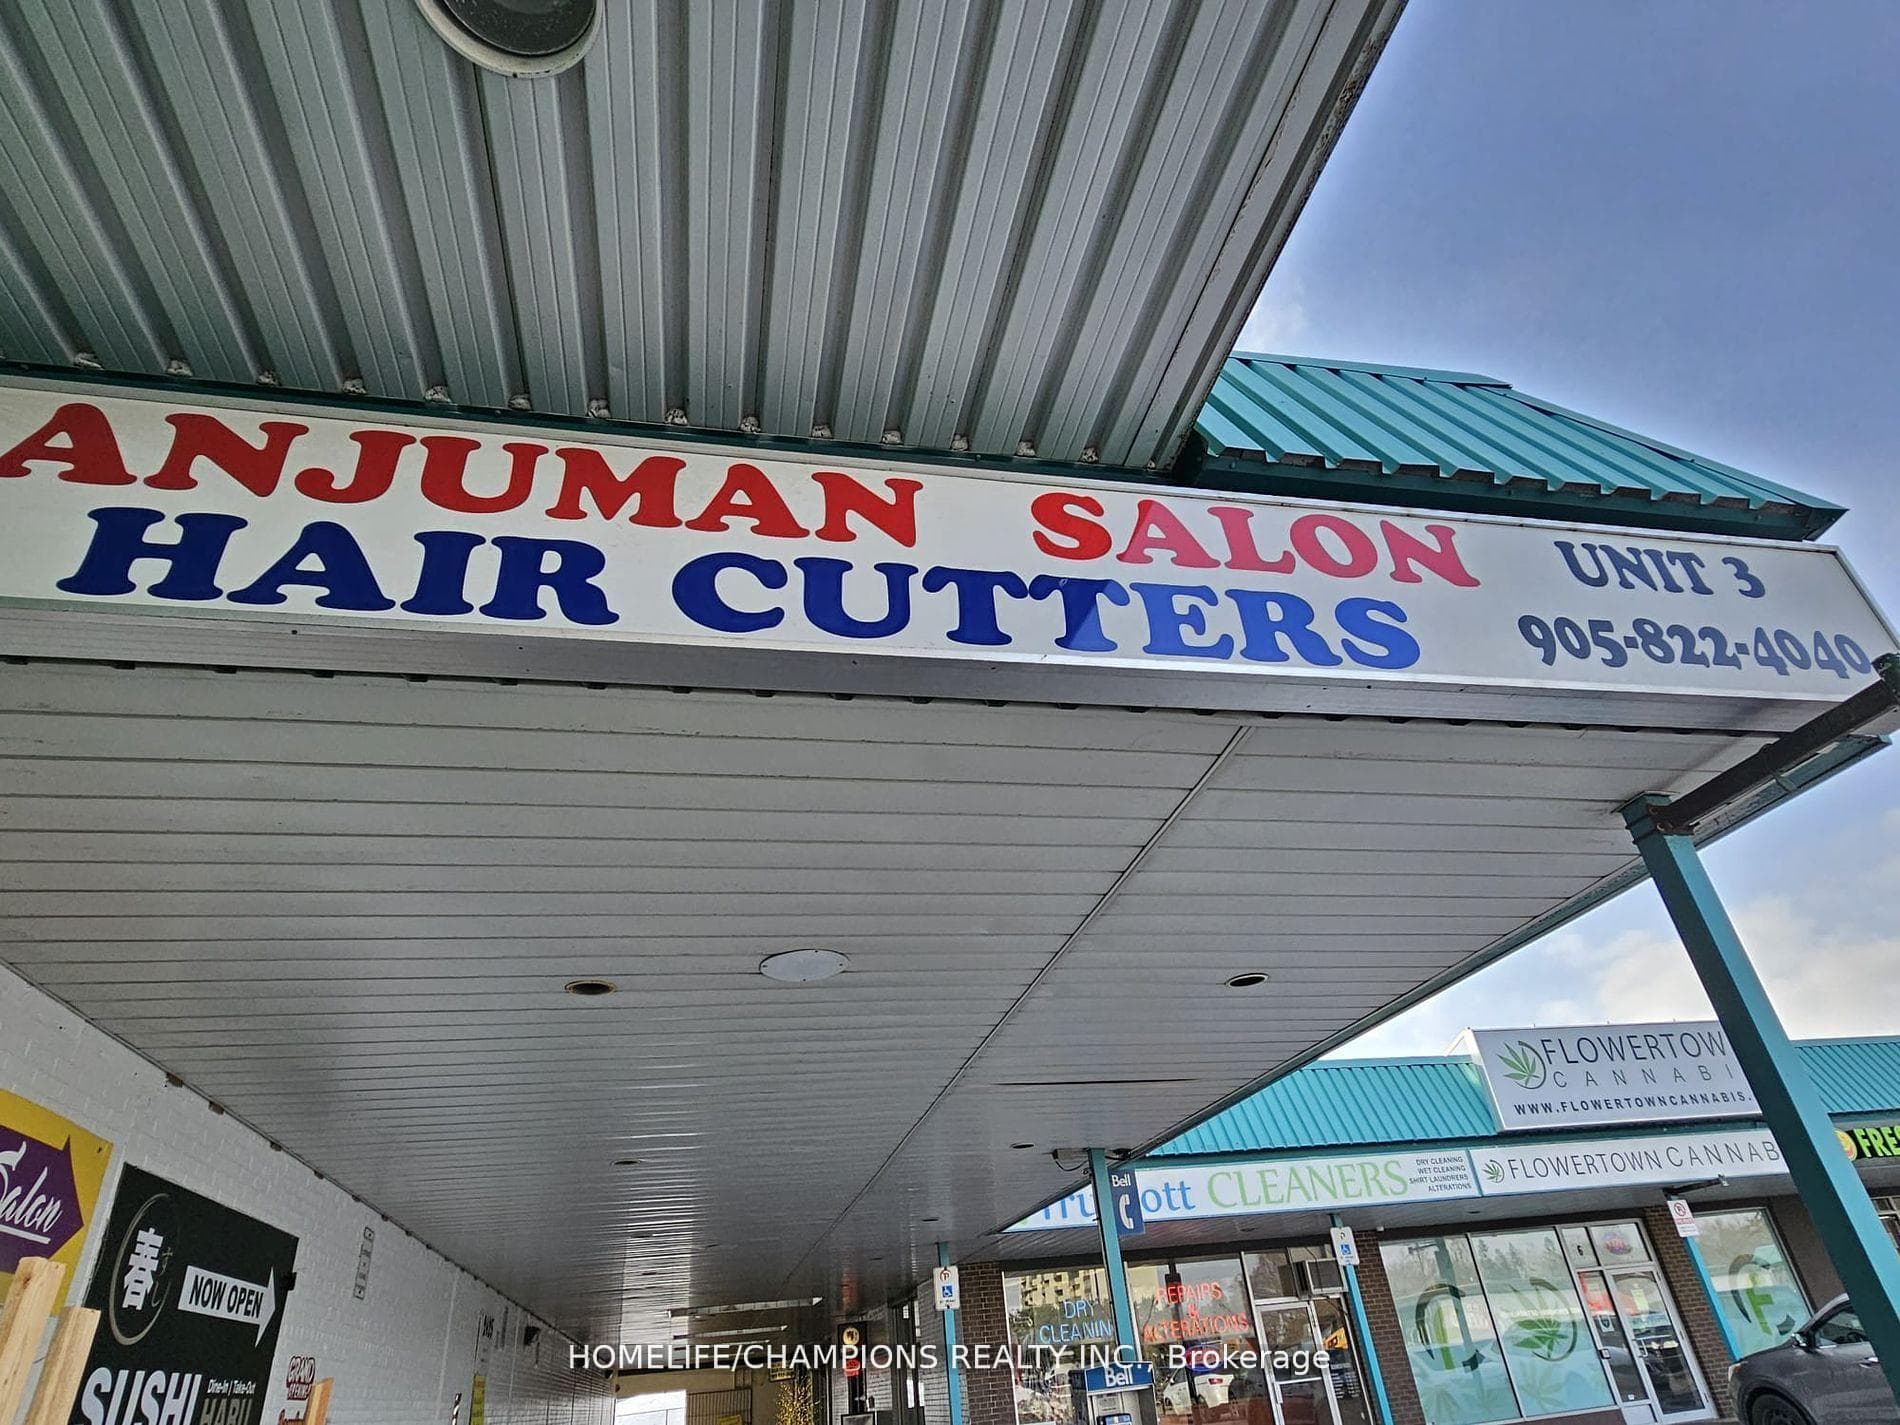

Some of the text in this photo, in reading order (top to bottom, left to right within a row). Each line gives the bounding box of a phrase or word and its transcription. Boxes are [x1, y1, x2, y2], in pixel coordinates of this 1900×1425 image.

[0, 403, 1481, 587] ANJUMAN SALON
[1553, 540, 1766, 598] UNIT 3
[56, 506, 1421, 670] HAIR CUTTERS
[1518, 614, 1873, 679] 905-822-4040
[1540, 1031, 1727, 1065] FLOWERTOW
[1553, 1062, 1735, 1088] CANNABI
[1514, 1091, 1753, 1116] WWW.FLOWERTOWNCANNABIS.
[1416, 1156, 1463, 1166] DRY CLEANING
[1417, 1165, 1466, 1175] WET CLEANING
[1507, 1140, 1780, 1180] FLOWERTOWN CANNAB
[1111, 1174, 1131, 1187] Bell
[1207, 1160, 1408, 1209] CLEANERS
[1428, 1183, 1472, 1192] ALTERATIONS
[189, 1274, 264, 1319] NOW OPEN
[1154, 1282, 1223, 1305] REPAIRS
[1063, 1299, 1096, 1320] DRY
[1039, 1320, 1113, 1345] CLEANIN
[1142, 1312, 1249, 1343] ALTERATIONS
[207, 1379, 229, 1395] Dine-In
[1104, 1366, 1134, 1388] Bell
[81, 1366, 202, 1425] SUSHI
